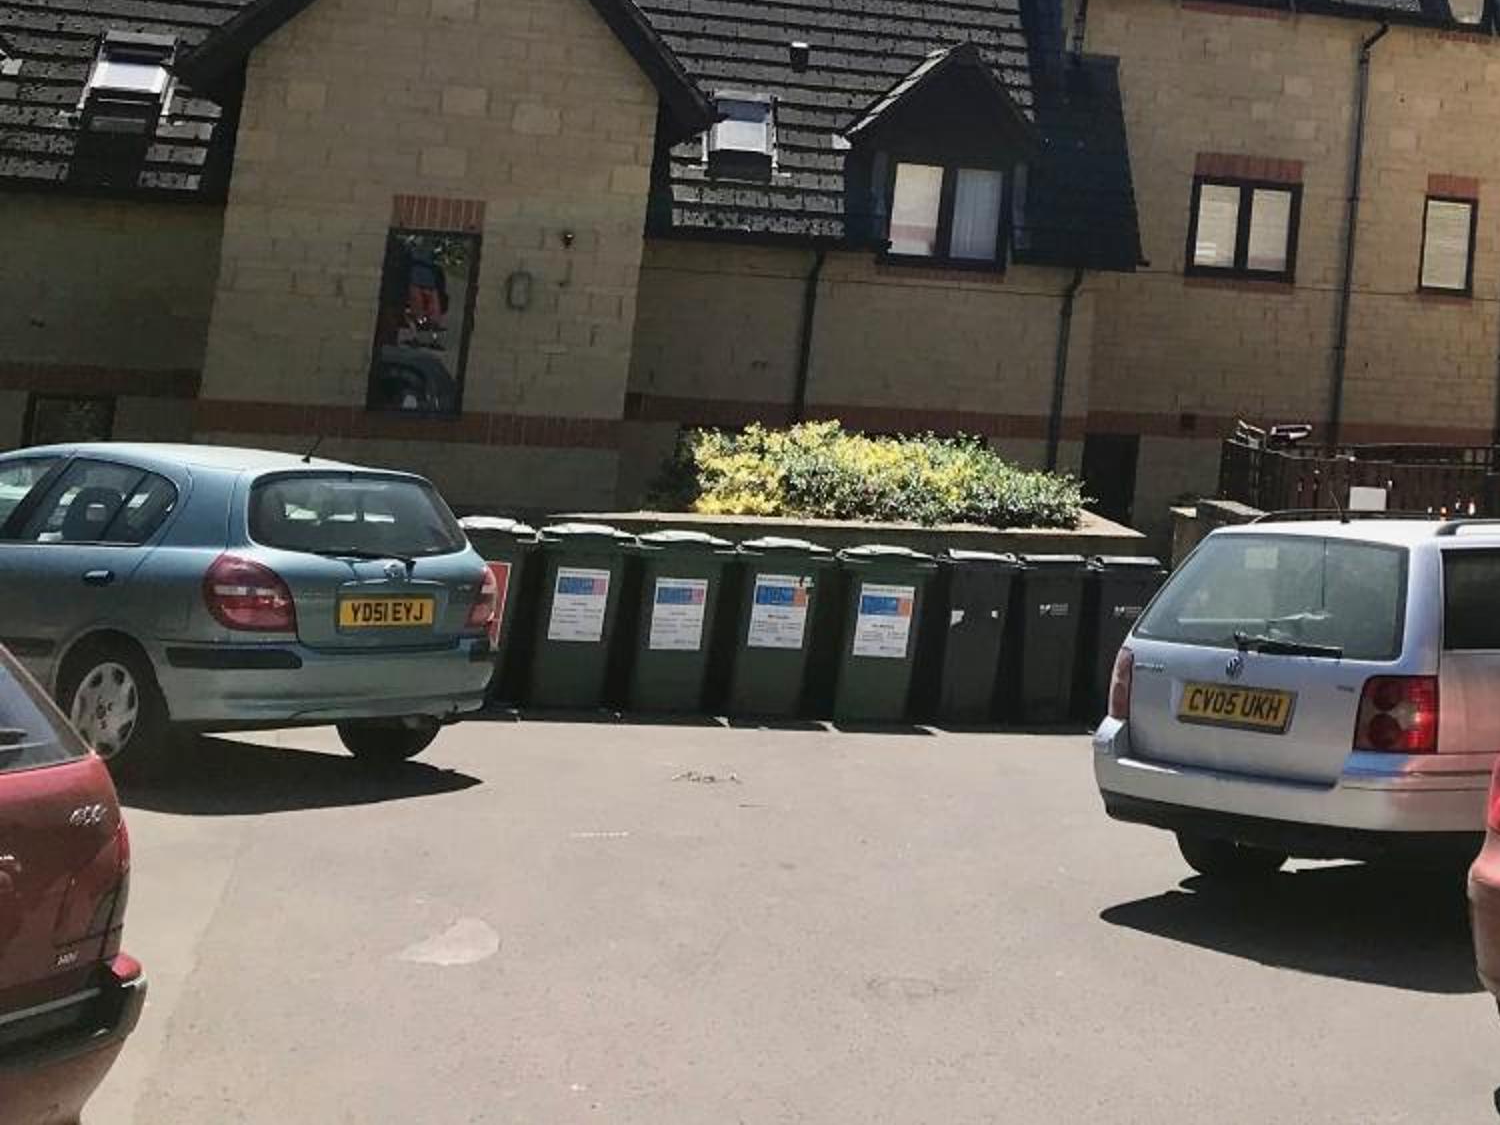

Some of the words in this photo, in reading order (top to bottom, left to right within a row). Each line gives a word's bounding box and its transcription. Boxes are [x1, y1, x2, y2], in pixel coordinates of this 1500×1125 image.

[352, 602, 389, 623] YD51
[392, 602, 424, 622] EYJ
[1189, 688, 1238, 716] CV05
[1240, 693, 1284, 722] UKH
